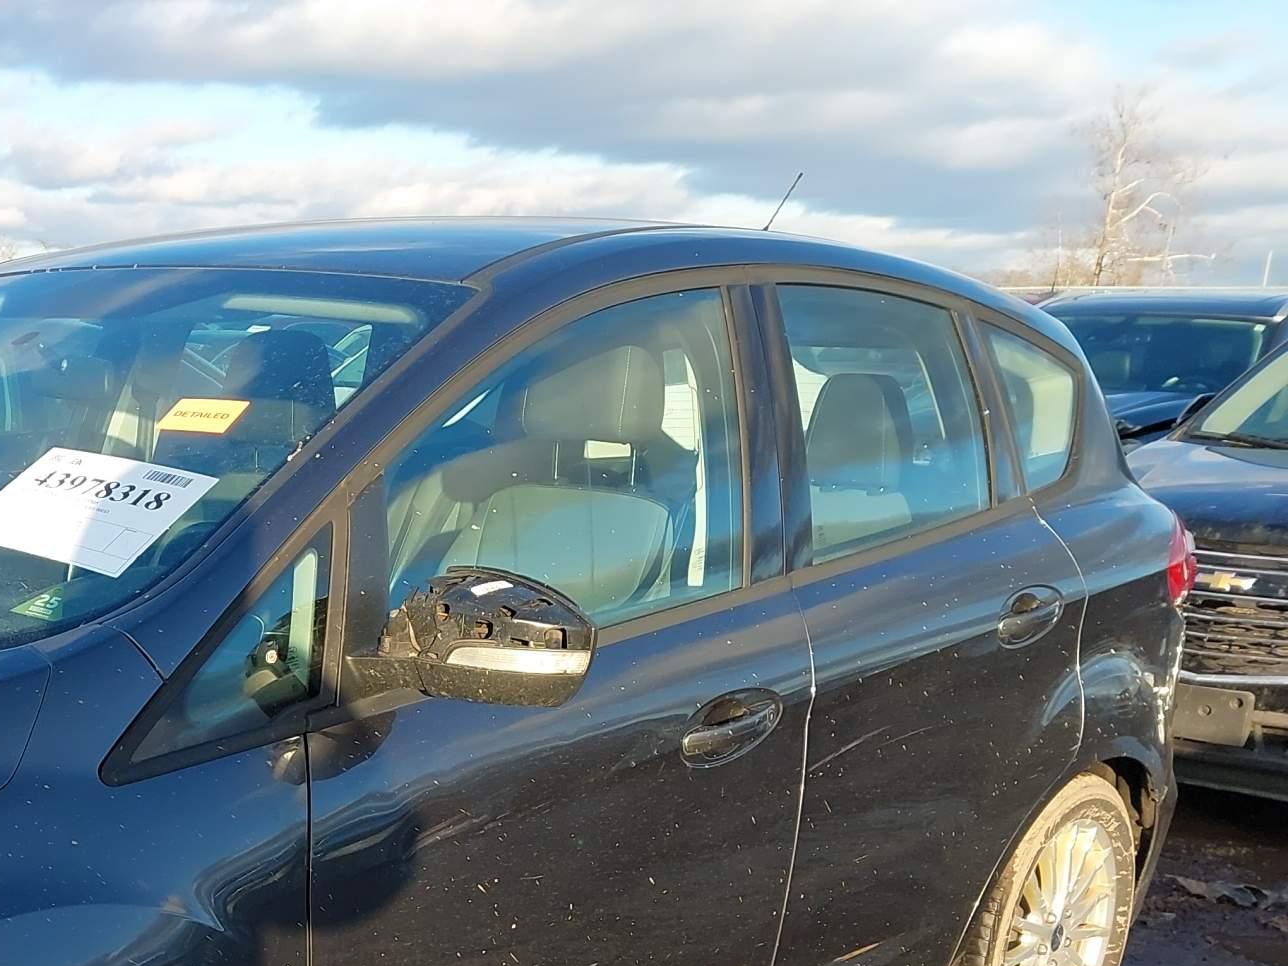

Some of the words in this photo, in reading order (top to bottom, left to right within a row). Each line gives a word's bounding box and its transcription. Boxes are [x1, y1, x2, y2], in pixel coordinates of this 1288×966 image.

[173, 410, 231, 420] DETAILED
[34, 470, 172, 511] 43978318
[33, 594, 62, 609] 25
